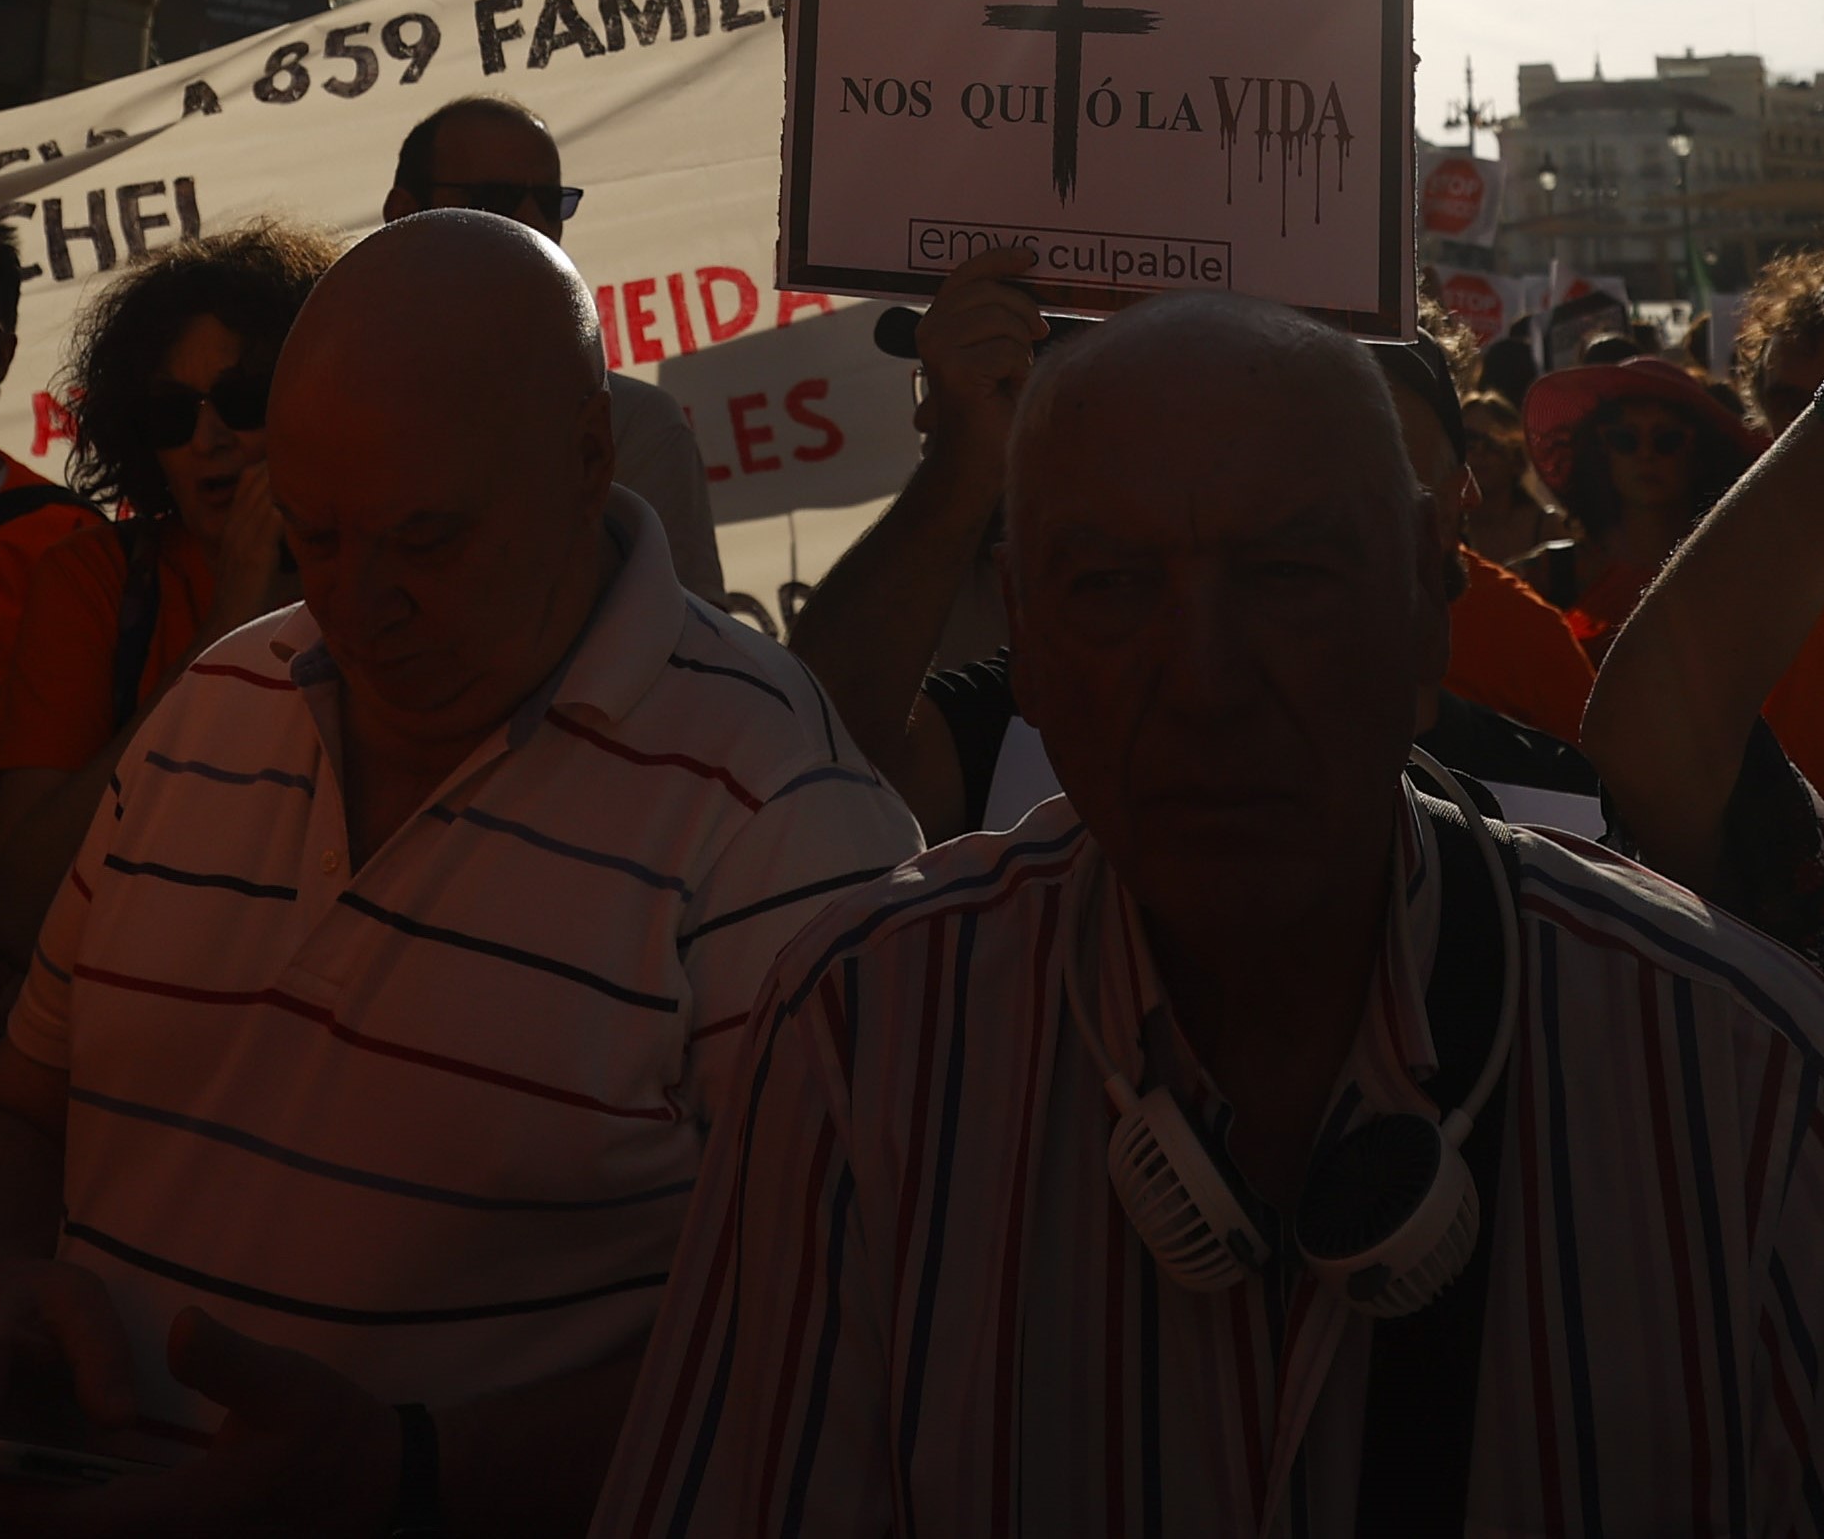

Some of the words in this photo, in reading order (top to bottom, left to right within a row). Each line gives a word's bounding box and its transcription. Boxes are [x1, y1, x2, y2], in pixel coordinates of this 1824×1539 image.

[253, 13, 441, 104] 859
[840, 77, 933, 118] NOS
[1136, 91, 1203, 132] LA
[1210, 76, 1354, 181] VIDA
[1048, 238, 1223, 283] culpable
